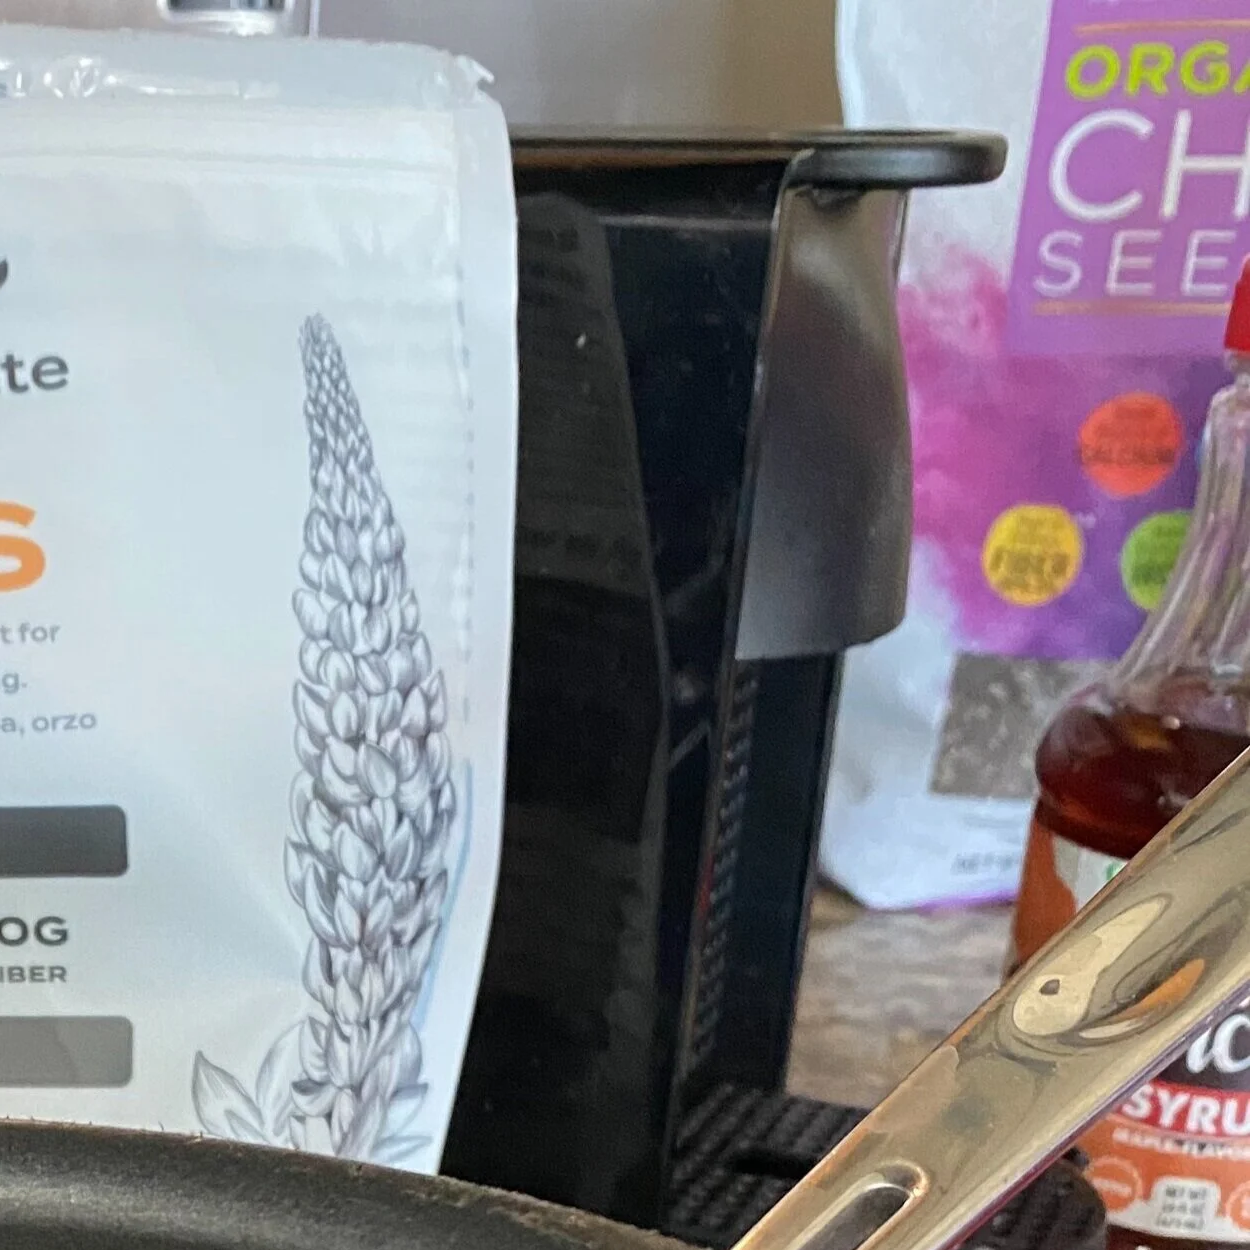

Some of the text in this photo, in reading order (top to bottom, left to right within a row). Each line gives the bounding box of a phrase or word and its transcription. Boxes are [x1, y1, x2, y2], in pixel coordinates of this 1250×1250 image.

[1049, 109, 1250, 222] CH
[1034, 228, 1237, 298] SEE
[19, 622, 61, 643] for
[32, 713, 97, 732] orzo
